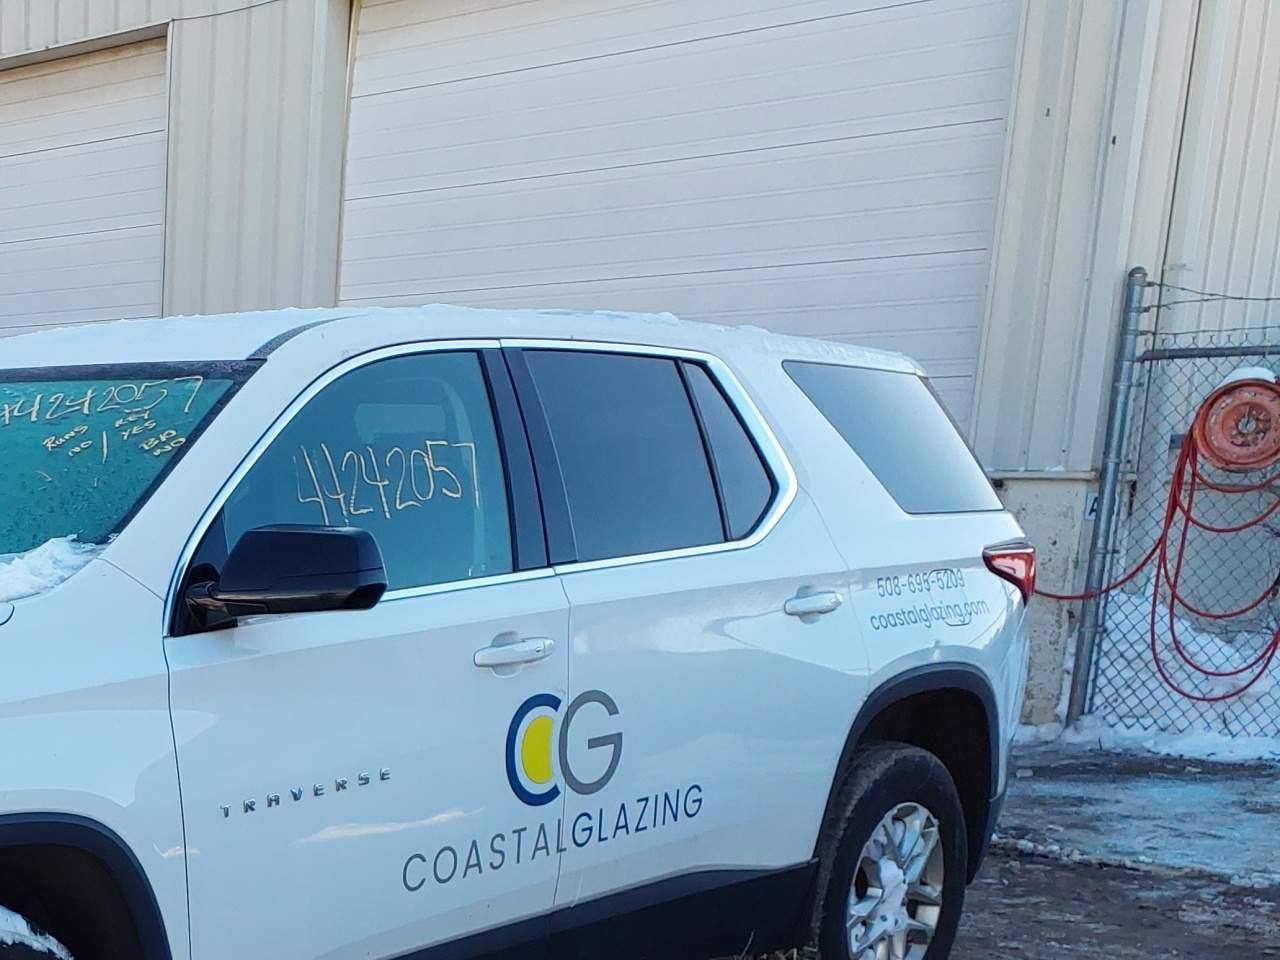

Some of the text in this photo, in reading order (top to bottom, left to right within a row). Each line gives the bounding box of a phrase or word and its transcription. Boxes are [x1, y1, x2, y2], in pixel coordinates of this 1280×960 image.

[121, 419, 157, 440] YES
[293, 439, 480, 526] 44242057
[870, 599, 991, 631] coastalglazing.com
[219, 767, 392, 818] TRAVERSE
[402, 784, 704, 892] COASTALGLAZING
